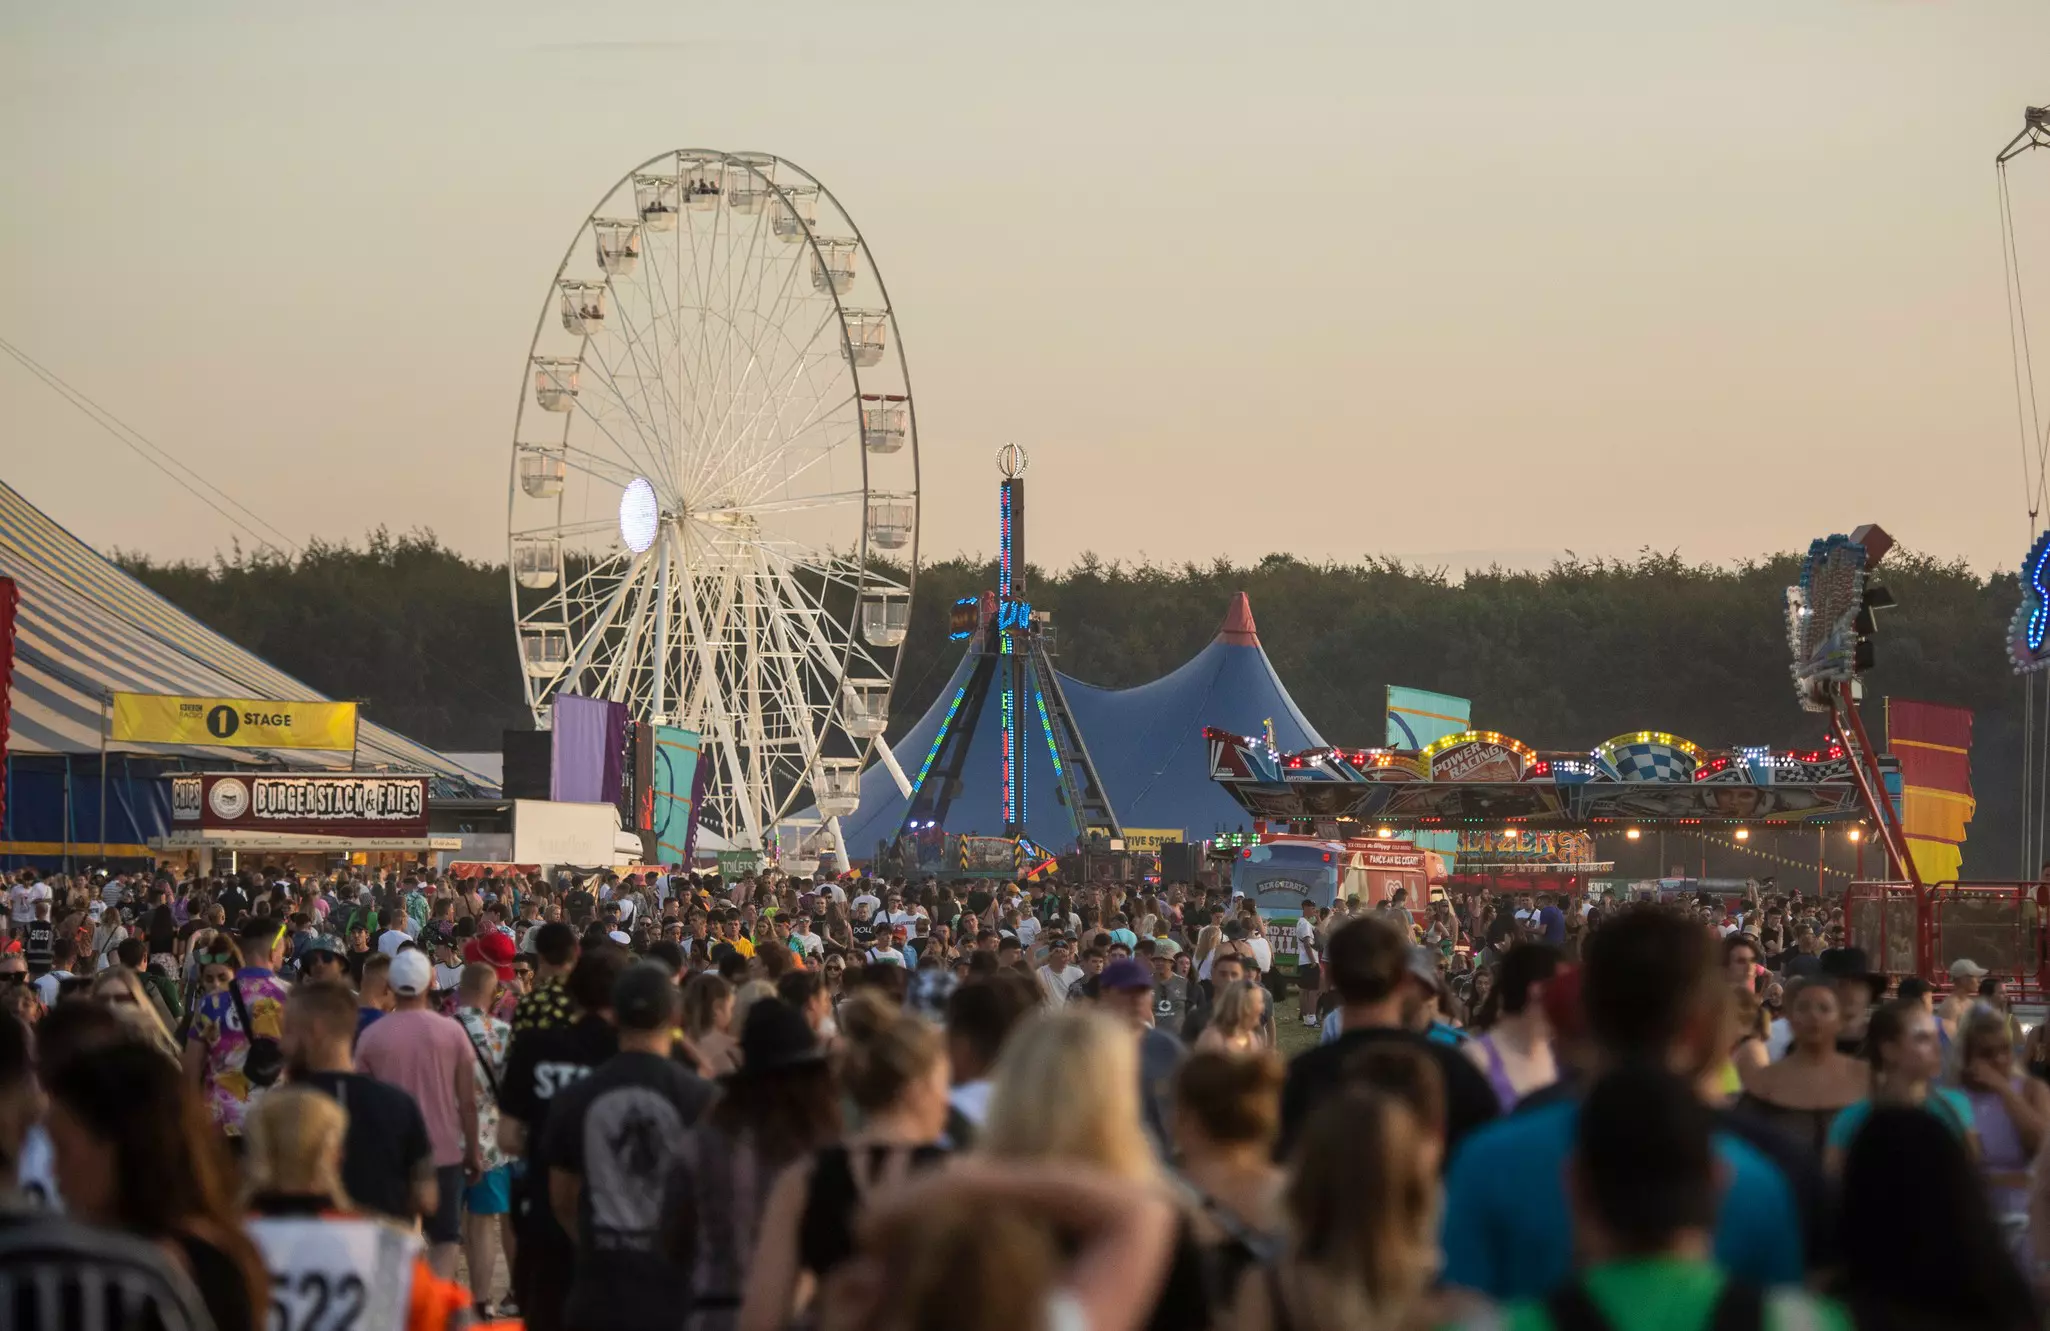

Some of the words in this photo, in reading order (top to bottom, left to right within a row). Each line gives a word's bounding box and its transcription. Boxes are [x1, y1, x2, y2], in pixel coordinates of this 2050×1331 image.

[243, 712, 292, 727] STAGE
[1433, 741, 1482, 777] POWER
[1449, 744, 1500, 780] RACING
[173, 782, 200, 810] CHIPS
[376, 783, 421, 816] FRIES
[1125, 836, 1146, 847] TIVE
[1463, 830, 1556, 854] LIZER
[722, 861, 755, 873] TOILETS
[853, 926, 872, 934] DOLL
[1282, 926, 1297, 937] TH
